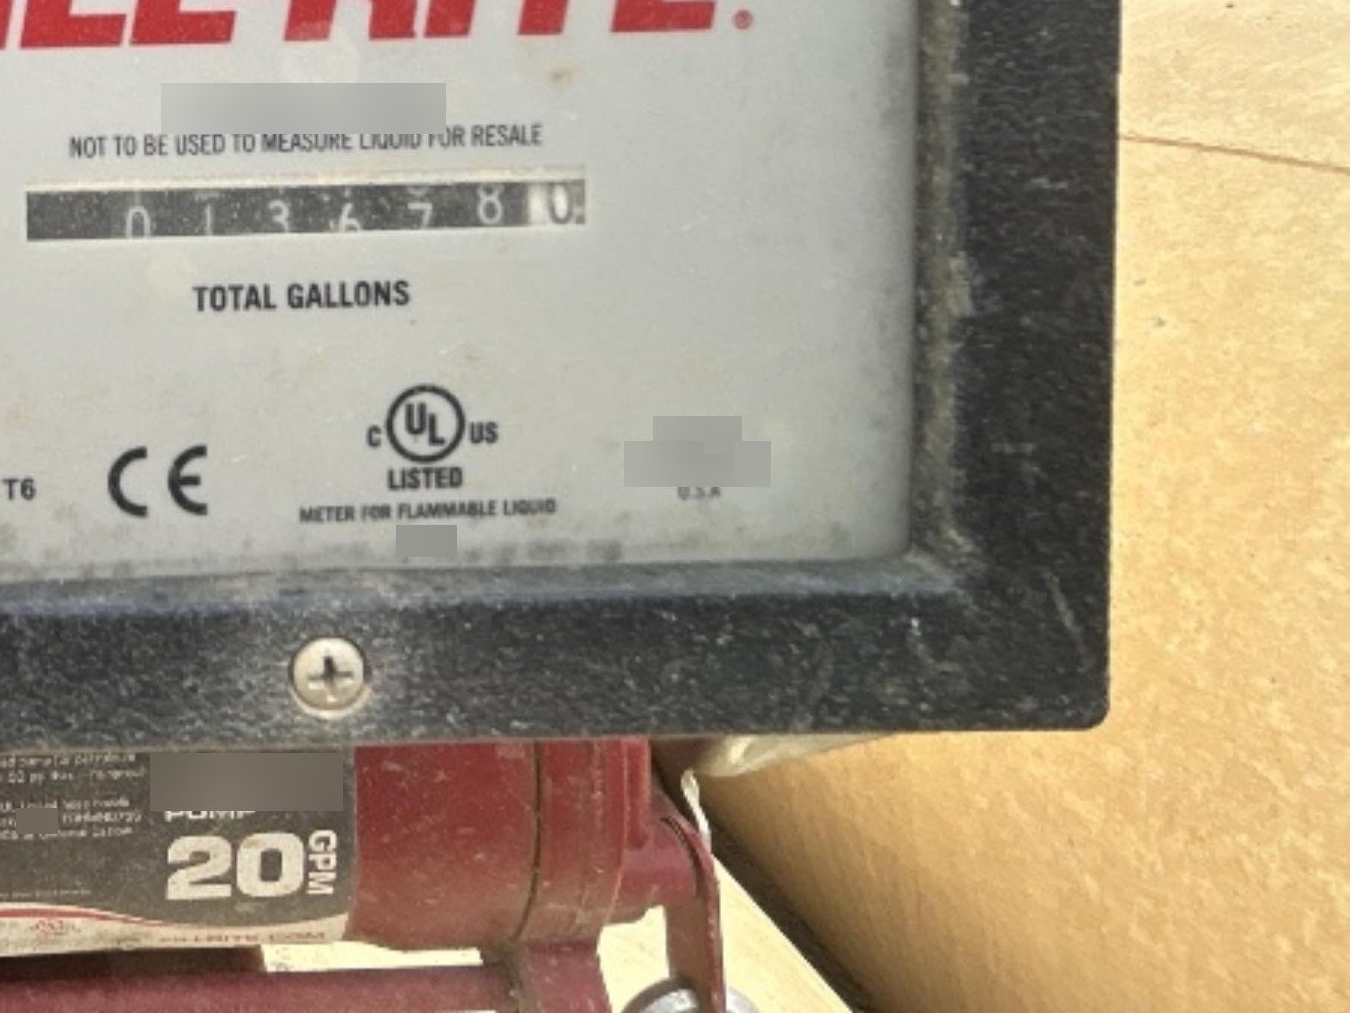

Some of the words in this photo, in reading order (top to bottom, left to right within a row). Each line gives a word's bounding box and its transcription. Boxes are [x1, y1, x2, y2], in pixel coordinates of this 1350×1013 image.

[69, 135, 107, 159] NOT
[113, 135, 138, 157] TO
[143, 134, 169, 156] BE
[176, 133, 226, 155] USED
[233, 133, 256, 153] TO
[261, 133, 351, 152] MEASURE
[470, 121, 544, 147] RESALE
[193, 283, 277, 312] TOTAL
[287, 280, 411, 308] GALLONS
[2, 478, 37, 501] T6
[387, 466, 464, 491] LISTED
[300, 504, 355, 524] METER
[361, 503, 392, 521] FOR
[398, 500, 497, 520] FLAMMABLE
[503, 497, 558, 517] LIQUID
[165, 831, 304, 900] 20
[306, 830, 338, 895] GPM
